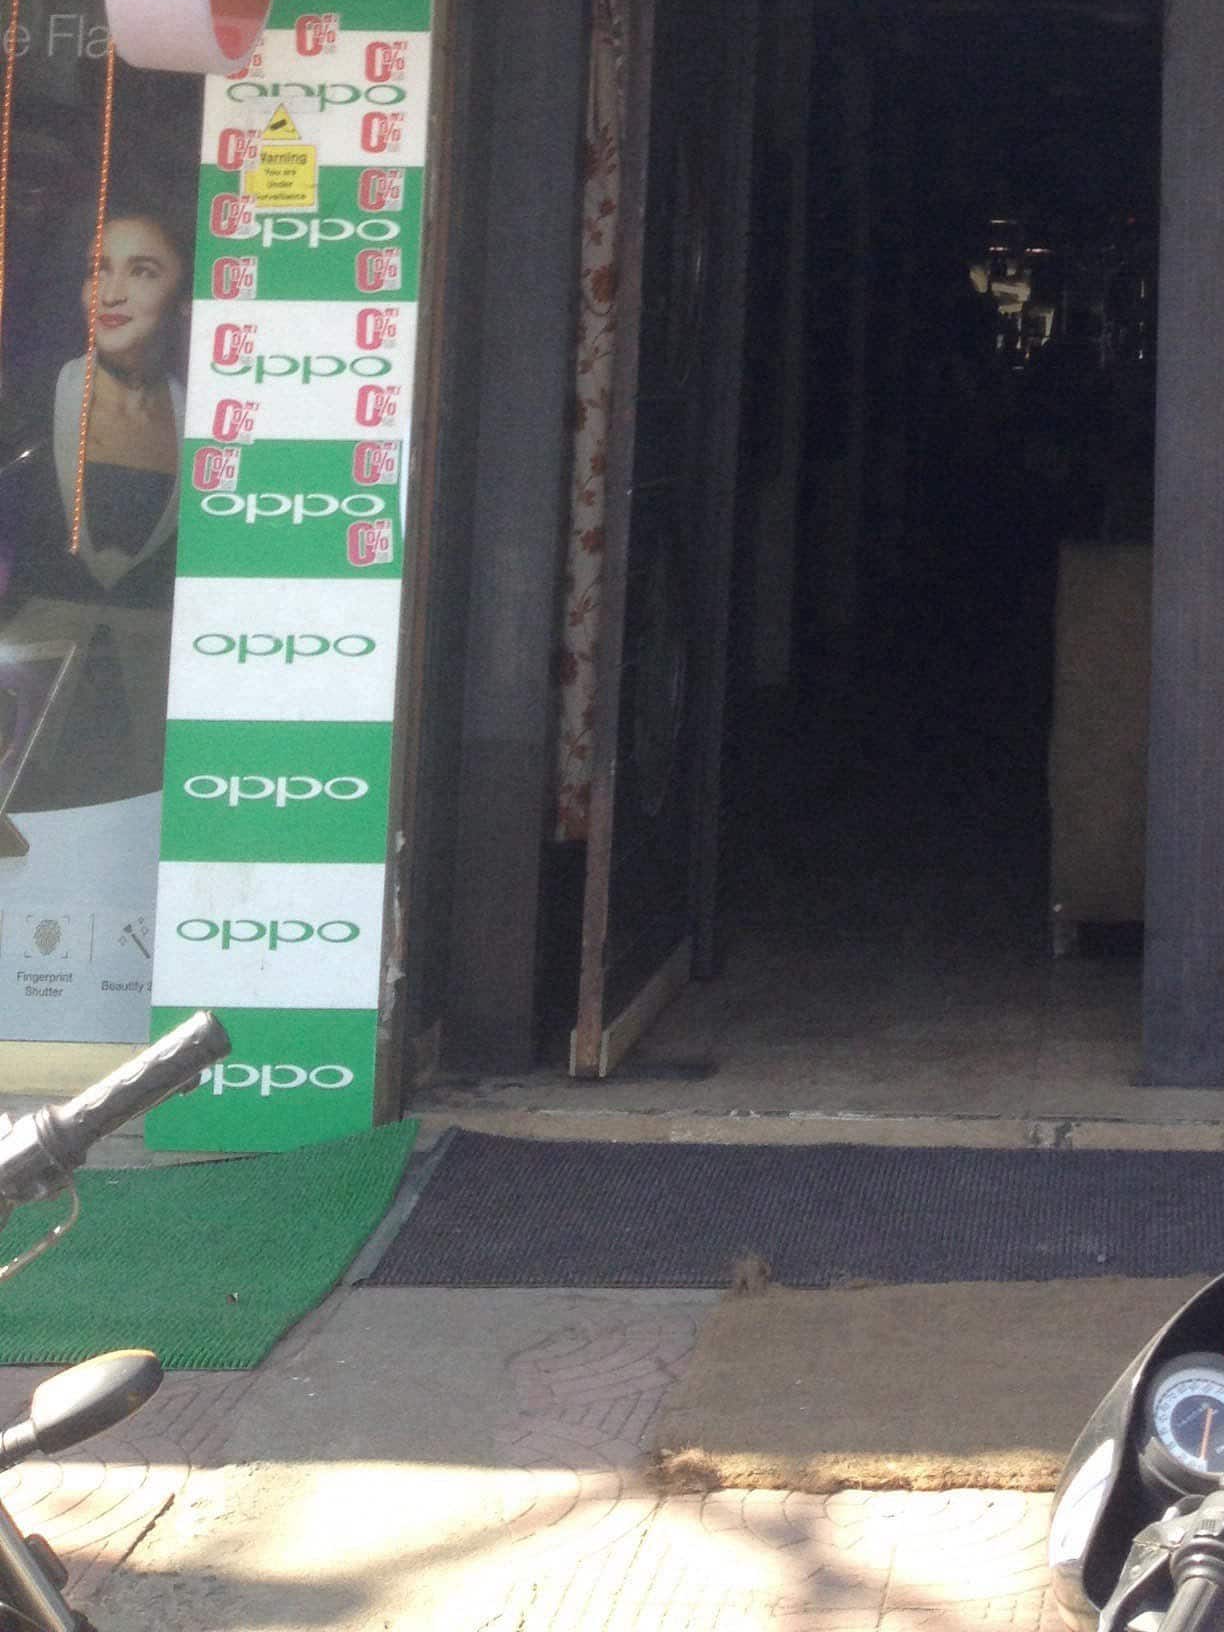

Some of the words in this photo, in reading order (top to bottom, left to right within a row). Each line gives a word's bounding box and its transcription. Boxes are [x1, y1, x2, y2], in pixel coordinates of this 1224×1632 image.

[200, 492, 387, 524] oppo
[192, 633, 377, 664] oppo
[183, 774, 369, 808] oppo
[176, 916, 361, 951] oppo
[16, 971, 73, 984] Fingerprint
[24, 986, 64, 998] Shutter
